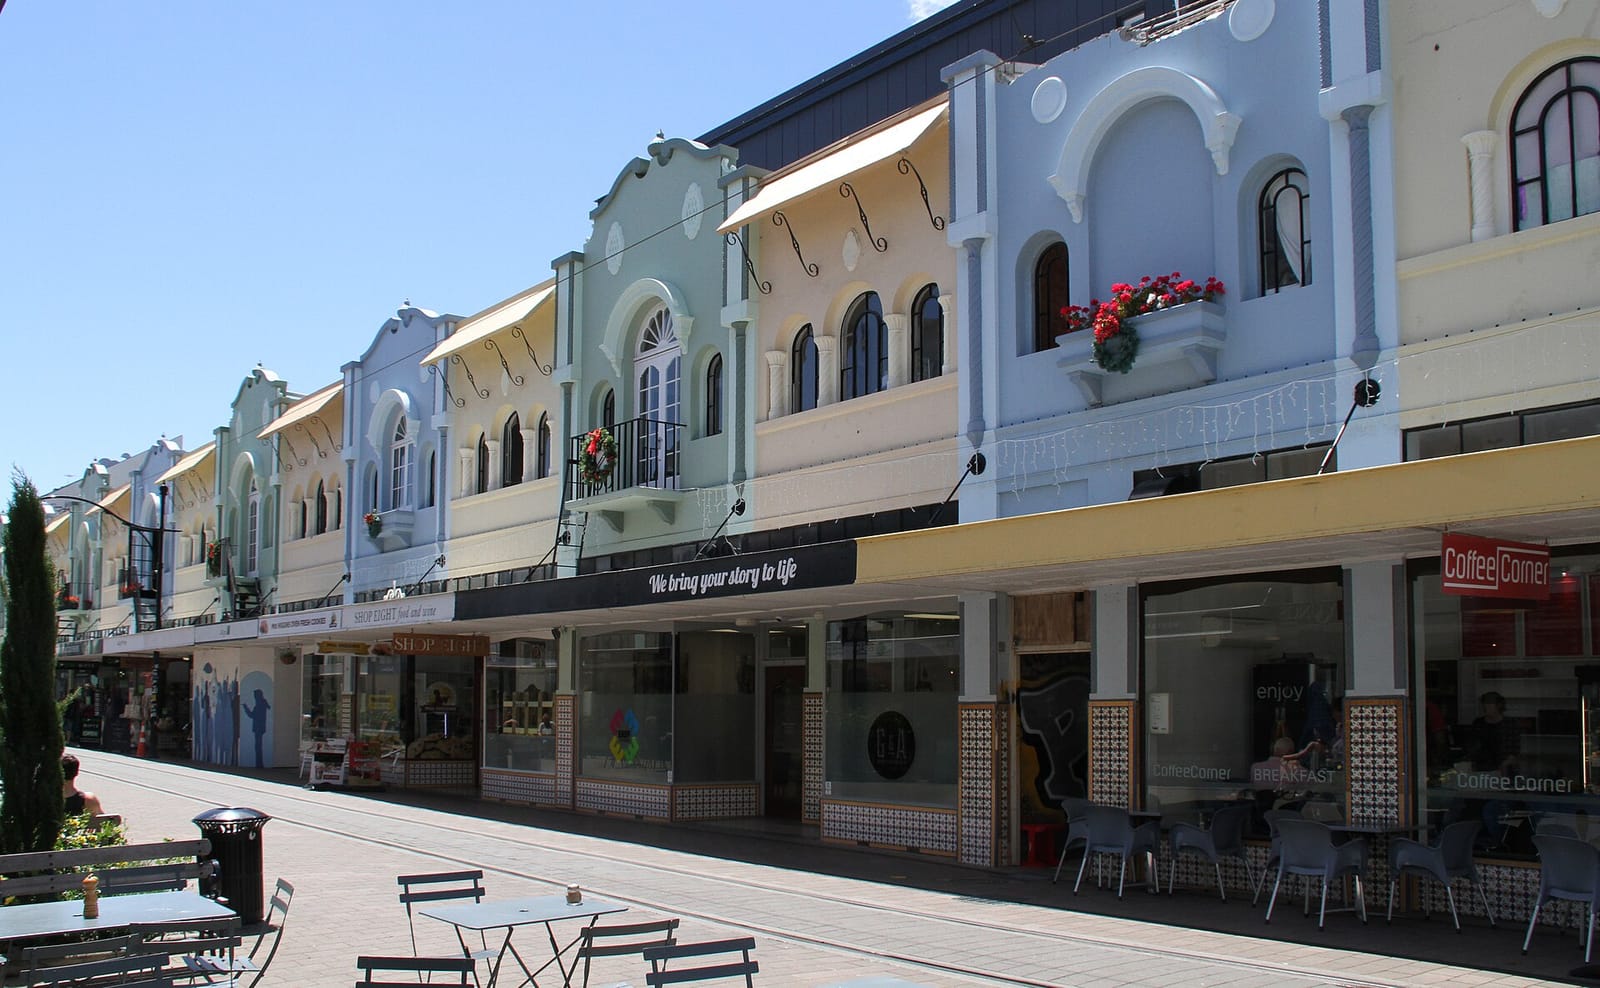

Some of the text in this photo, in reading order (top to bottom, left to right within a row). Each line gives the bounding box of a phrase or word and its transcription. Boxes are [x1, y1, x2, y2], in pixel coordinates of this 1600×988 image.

[1445, 547, 1549, 585] Coffee Corner
[648, 557, 797, 596] We bring your story to life
[354, 604, 437, 624] SHOP EIGHT food and wine
[394, 636, 435, 652] SHOP
[1256, 682, 1304, 702] enjoy
[1152, 763, 1232, 781] CoffeeCorner
[1253, 767, 1336, 784] BREAKFAST
[1456, 772, 1574, 793] Coffee Corner
